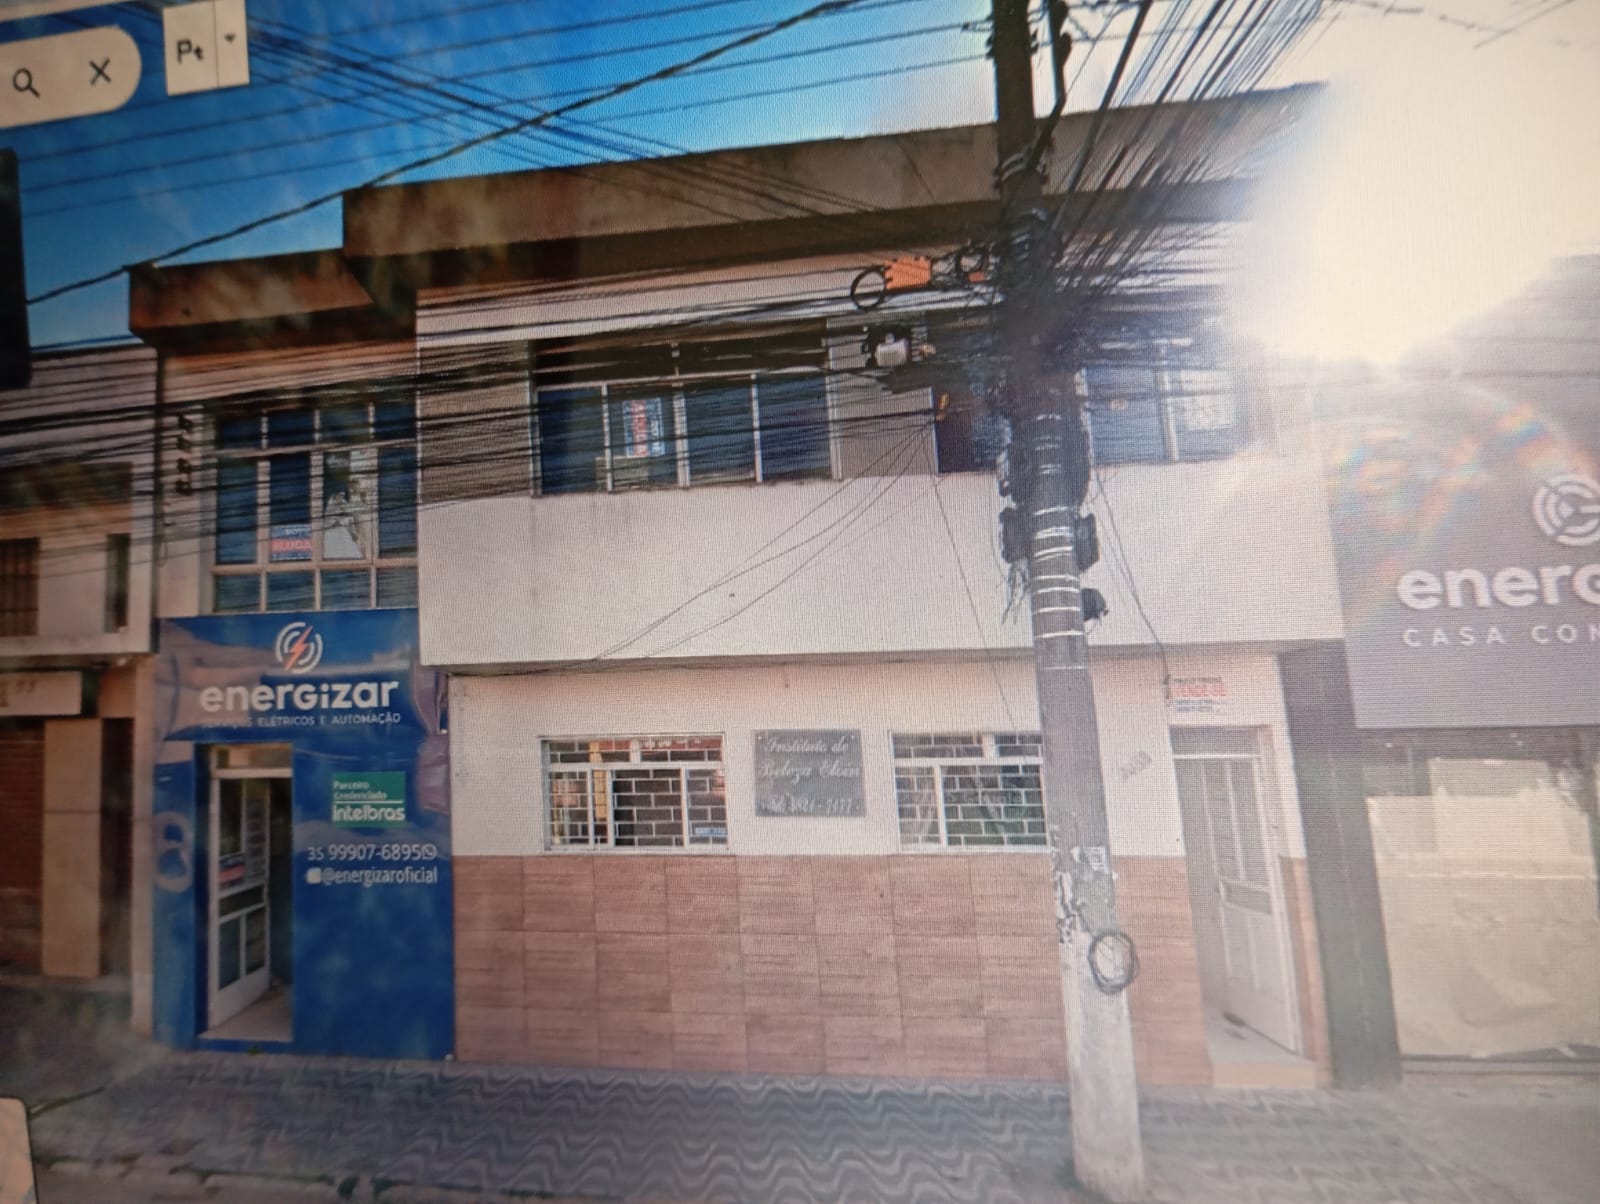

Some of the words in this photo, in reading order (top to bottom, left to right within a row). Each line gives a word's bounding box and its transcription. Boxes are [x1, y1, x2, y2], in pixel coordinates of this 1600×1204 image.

[177, 39, 204, 64] Pt
[1403, 626, 1505, 647] CASA
[258, 716, 315, 726] ELÉTRICOS
[320, 717, 327, 725] E
[331, 713, 401, 726] AUTOMAÇÃO
[333, 781, 370, 790] Parceiro
[333, 790, 388, 800] Credenciado
[308, 847, 325, 860] 35
[328, 843, 421, 861] 99907-6895
[322, 866, 438, 886] @energizaroficial
